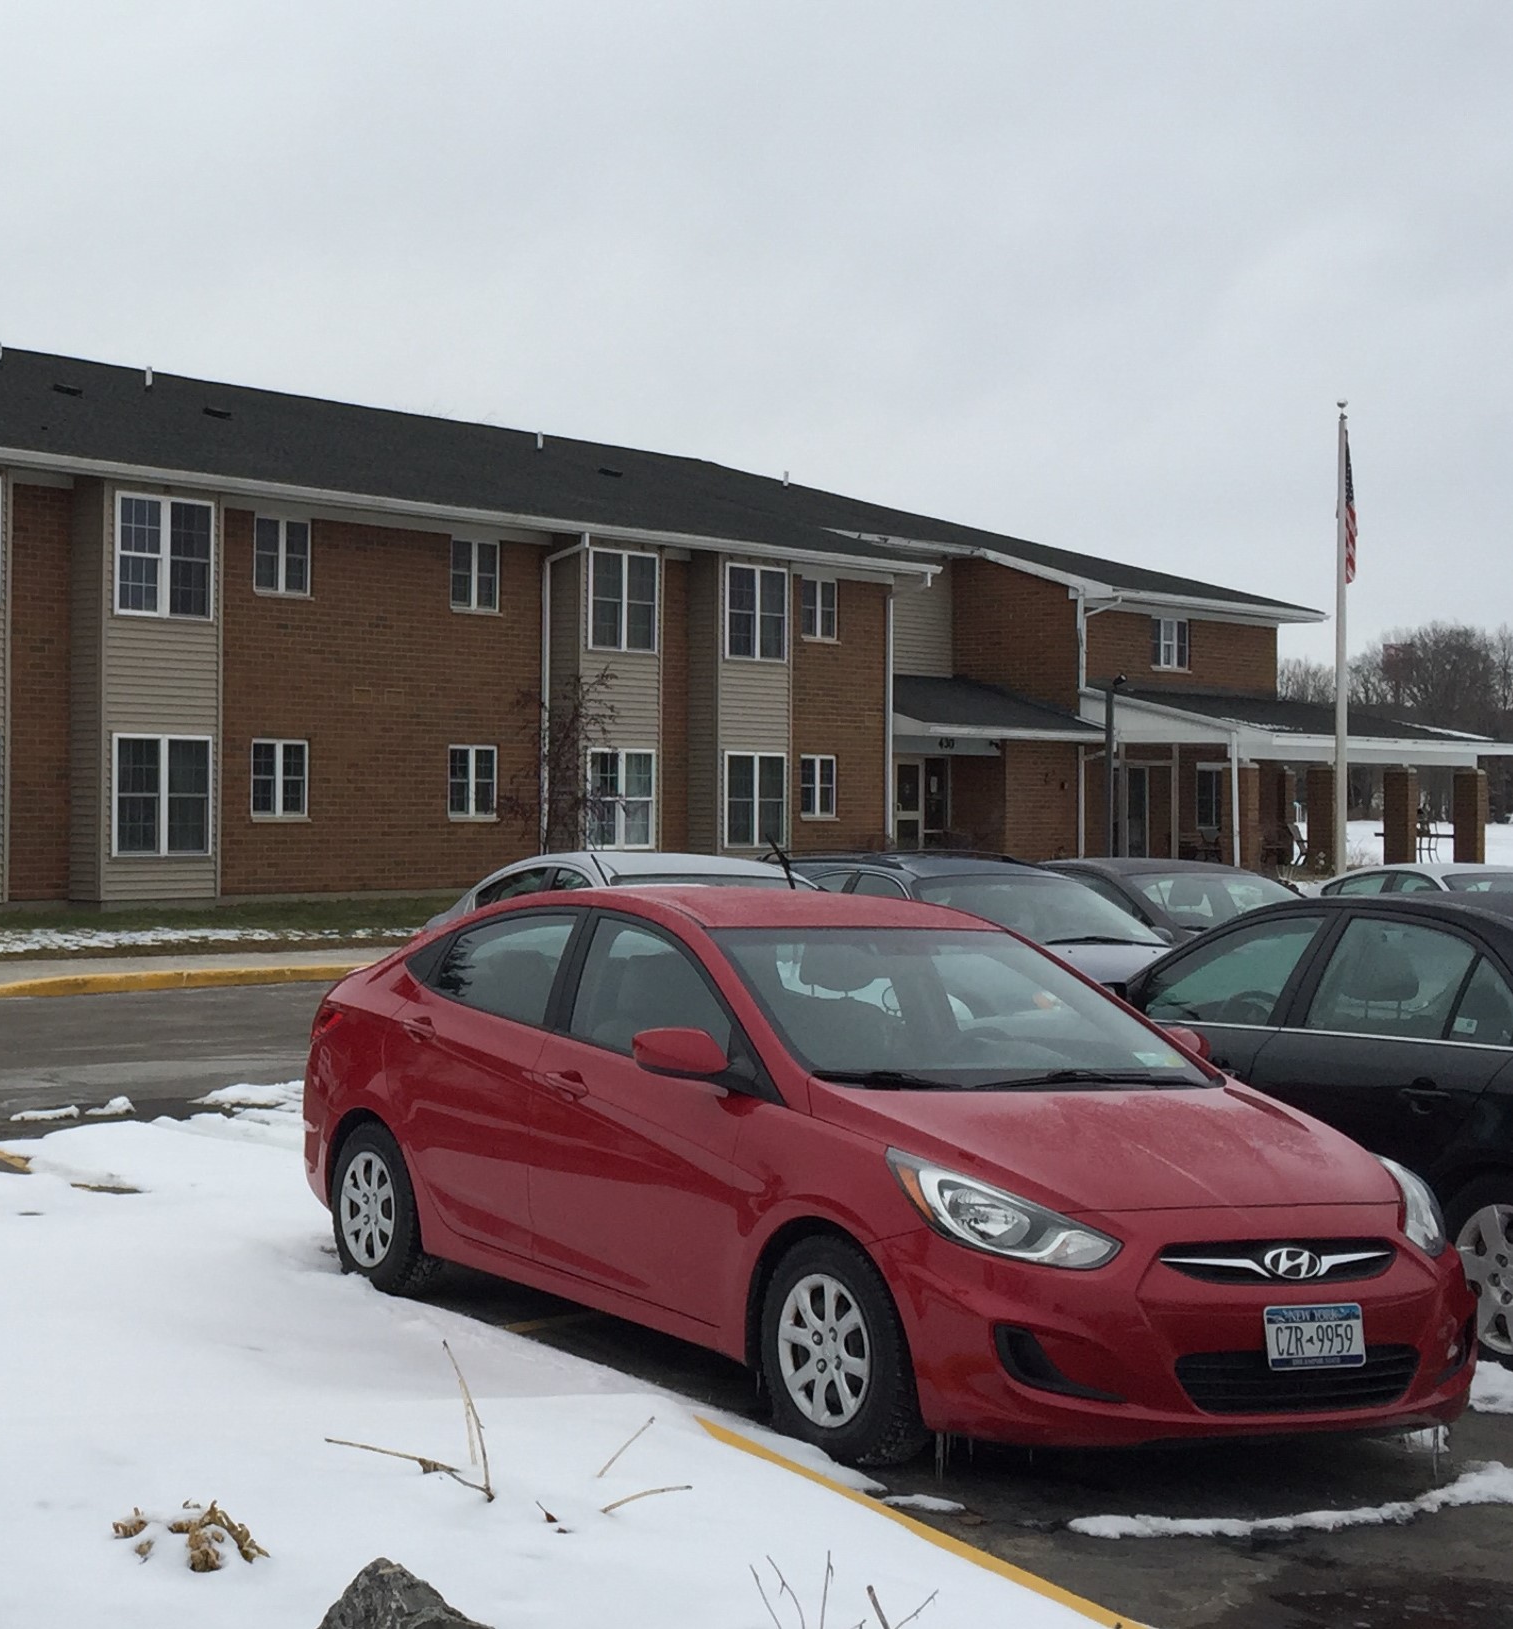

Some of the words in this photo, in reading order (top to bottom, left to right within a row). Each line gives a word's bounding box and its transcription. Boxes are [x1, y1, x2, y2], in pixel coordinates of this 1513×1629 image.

[1286, 1310, 1310, 1322] NEW
[1313, 1308, 1338, 1321] YORK
[1275, 1326, 1305, 1356] CZR
[1315, 1323, 1353, 1354] 9959
